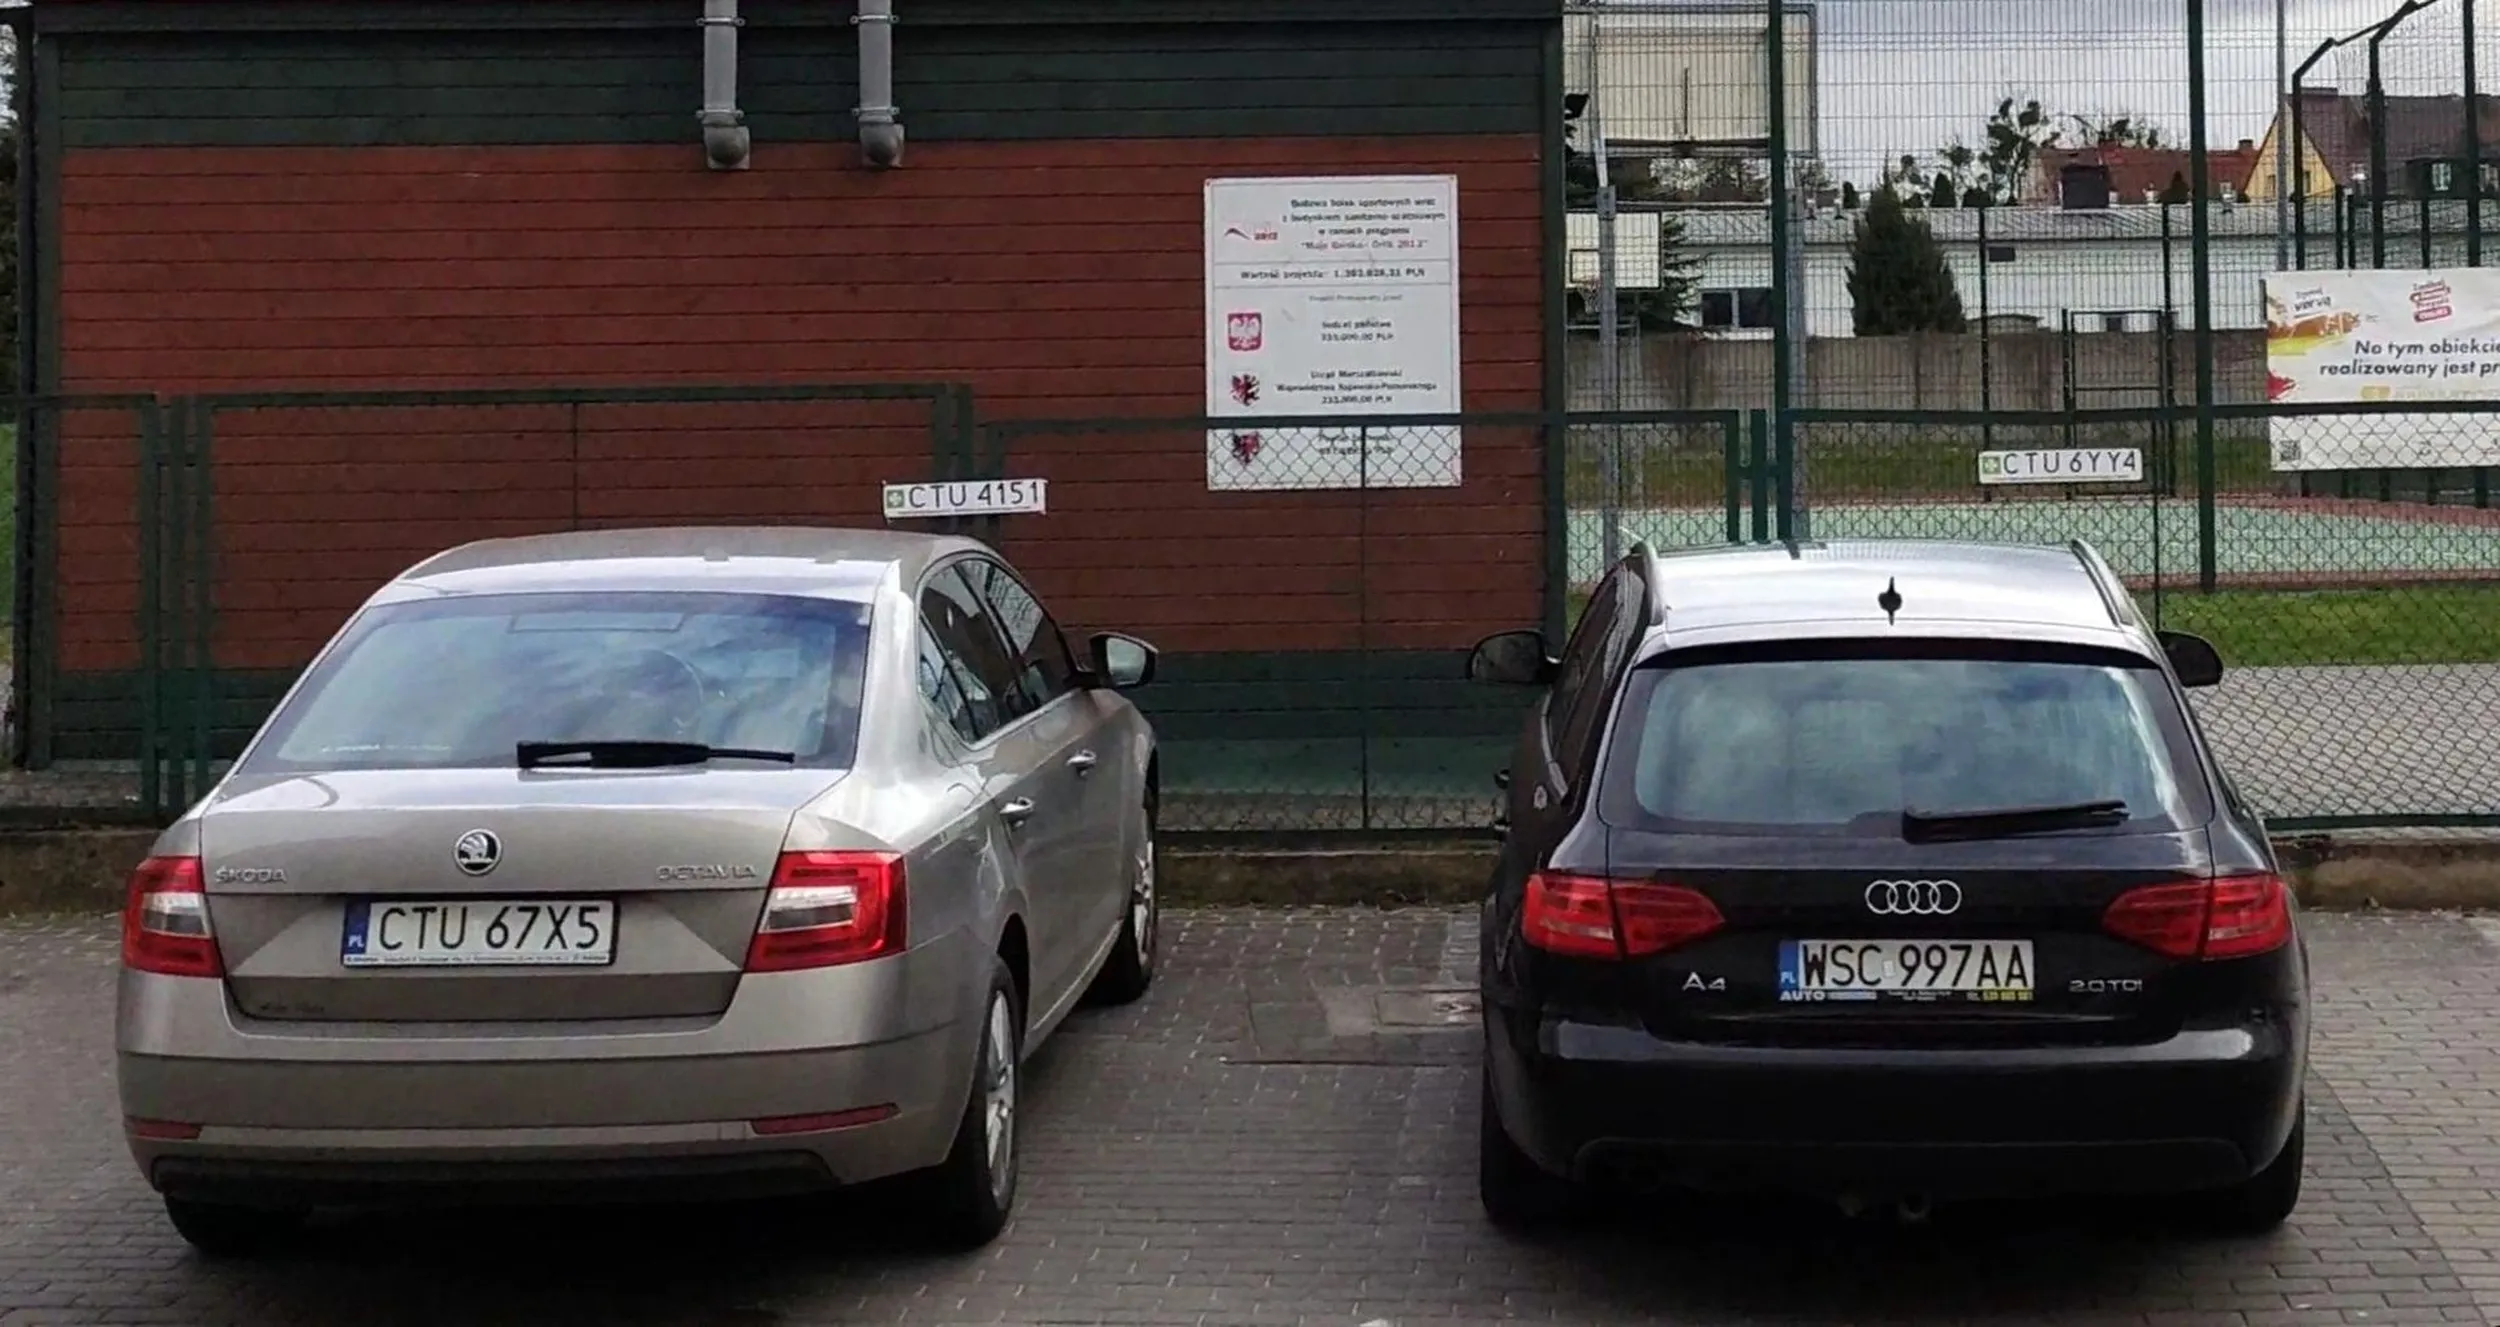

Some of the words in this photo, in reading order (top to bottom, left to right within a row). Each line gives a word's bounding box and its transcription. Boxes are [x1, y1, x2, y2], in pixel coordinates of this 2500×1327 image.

[2388, 341, 2423, 359] tym
[2319, 359, 2438, 378] realizowany
[2443, 358, 2476, 378] jest
[2003, 452, 2060, 475] CTU
[2069, 451, 2136, 473] 6YY4
[908, 484, 967, 509] CTU
[978, 481, 1039, 506] 4151
[656, 864, 758, 881] OCTAVIA
[347, 935, 365, 949] PL
[379, 906, 468, 951] CTU
[485, 905, 600, 951] 67X5
[1802, 943, 1883, 987] WSC
[1898, 943, 2029, 988] 997AA
[1682, 971, 1727, 991] A4
[1780, 990, 1826, 1001] AUTO
